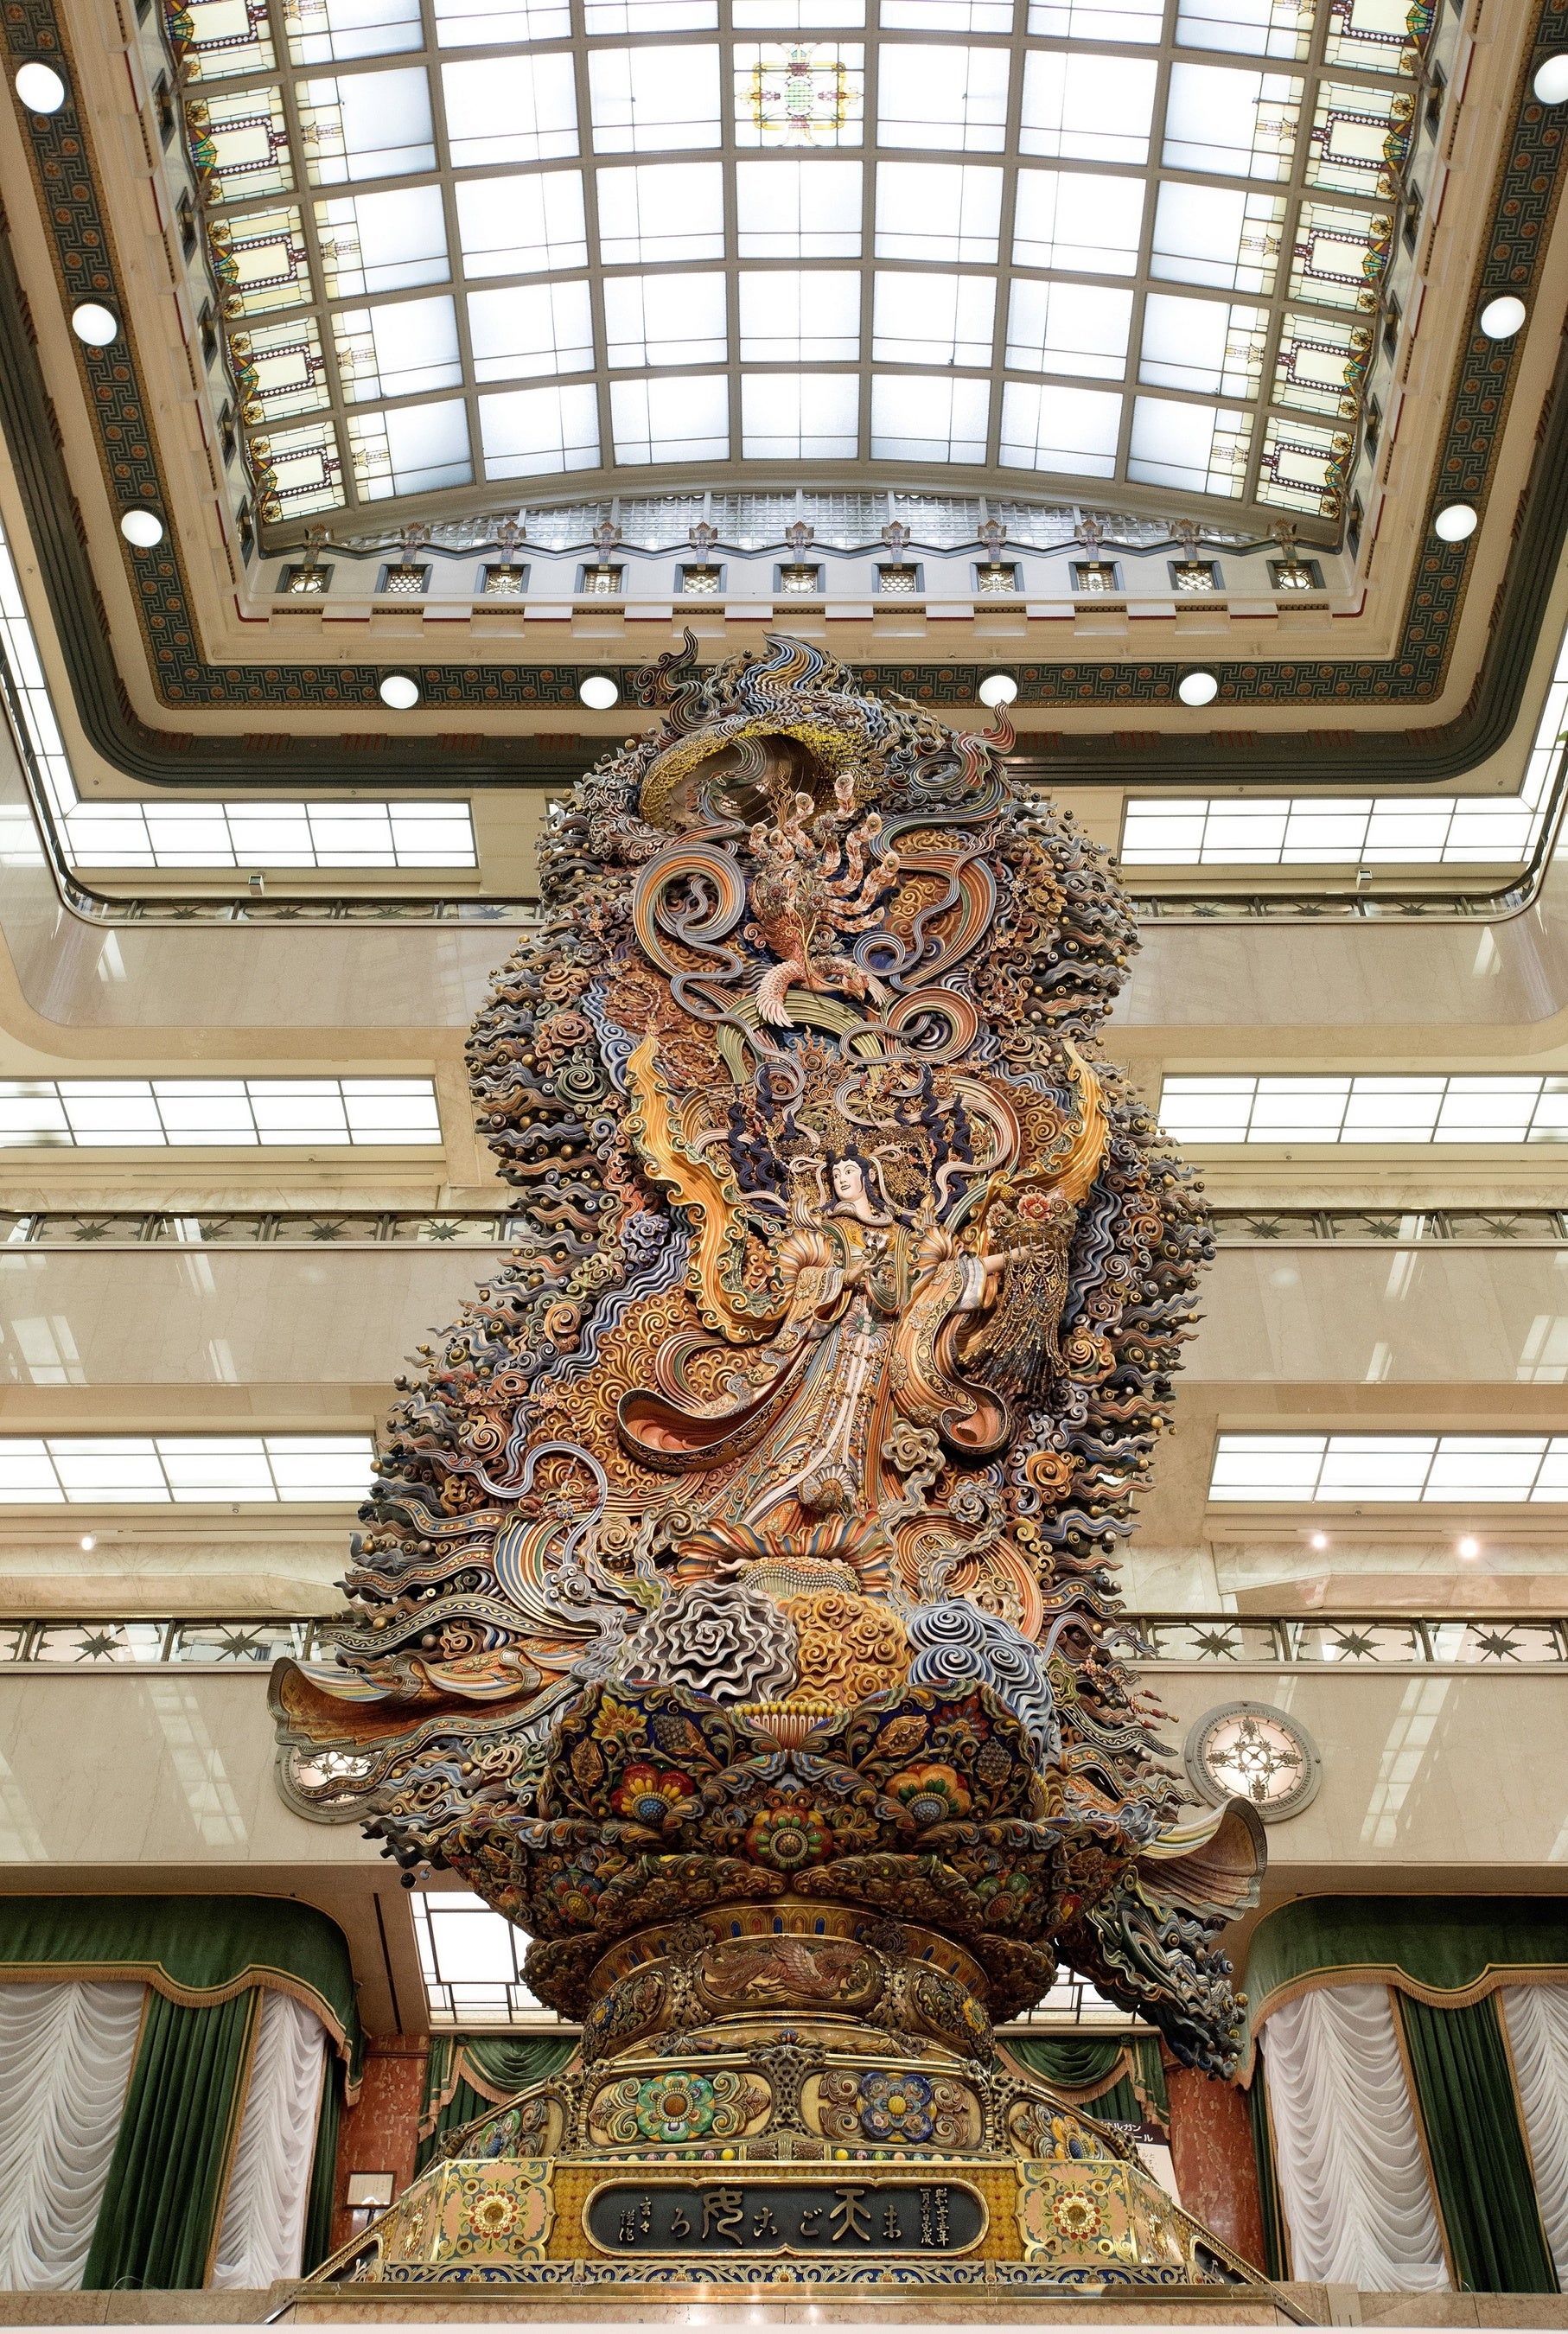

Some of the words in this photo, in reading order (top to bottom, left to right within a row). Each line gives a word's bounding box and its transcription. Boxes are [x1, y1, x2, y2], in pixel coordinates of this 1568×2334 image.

[934, 2187, 950, 2247] 昭和三十五年
